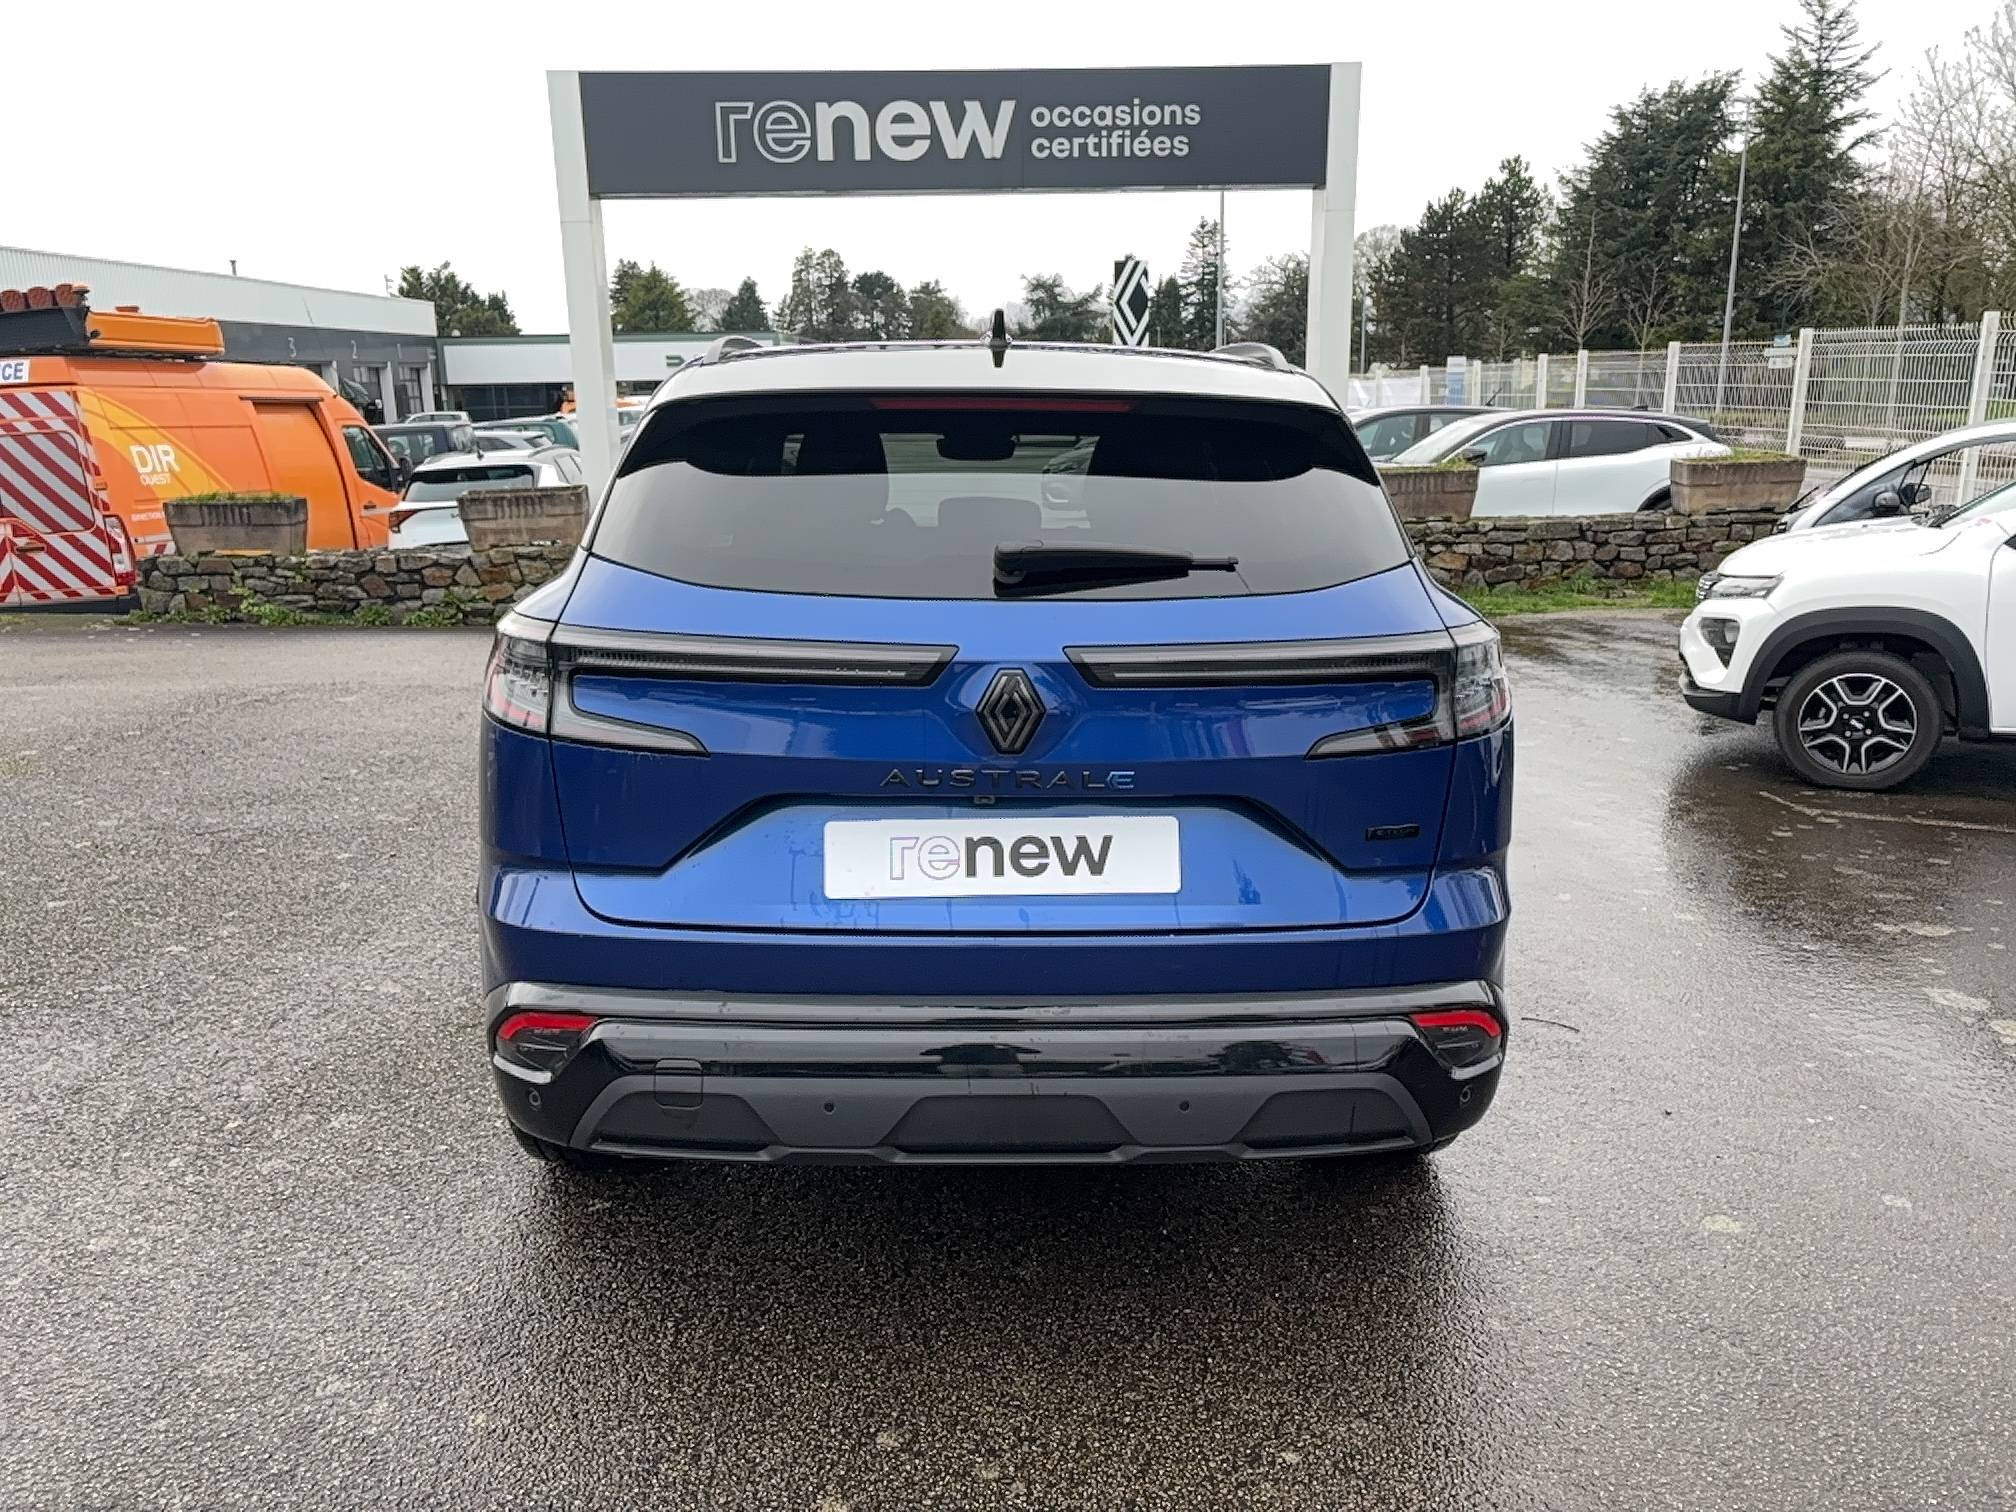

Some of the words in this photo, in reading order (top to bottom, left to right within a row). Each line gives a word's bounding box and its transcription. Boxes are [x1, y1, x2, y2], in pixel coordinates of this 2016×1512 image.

[1030, 97, 1202, 129] occasions
[714, 98, 1015, 164] renew
[1030, 130, 1190, 160] certifiées
[0, 361, 25, 381] CE
[129, 444, 181, 473] DIR
[889, 834, 1113, 881] renew
